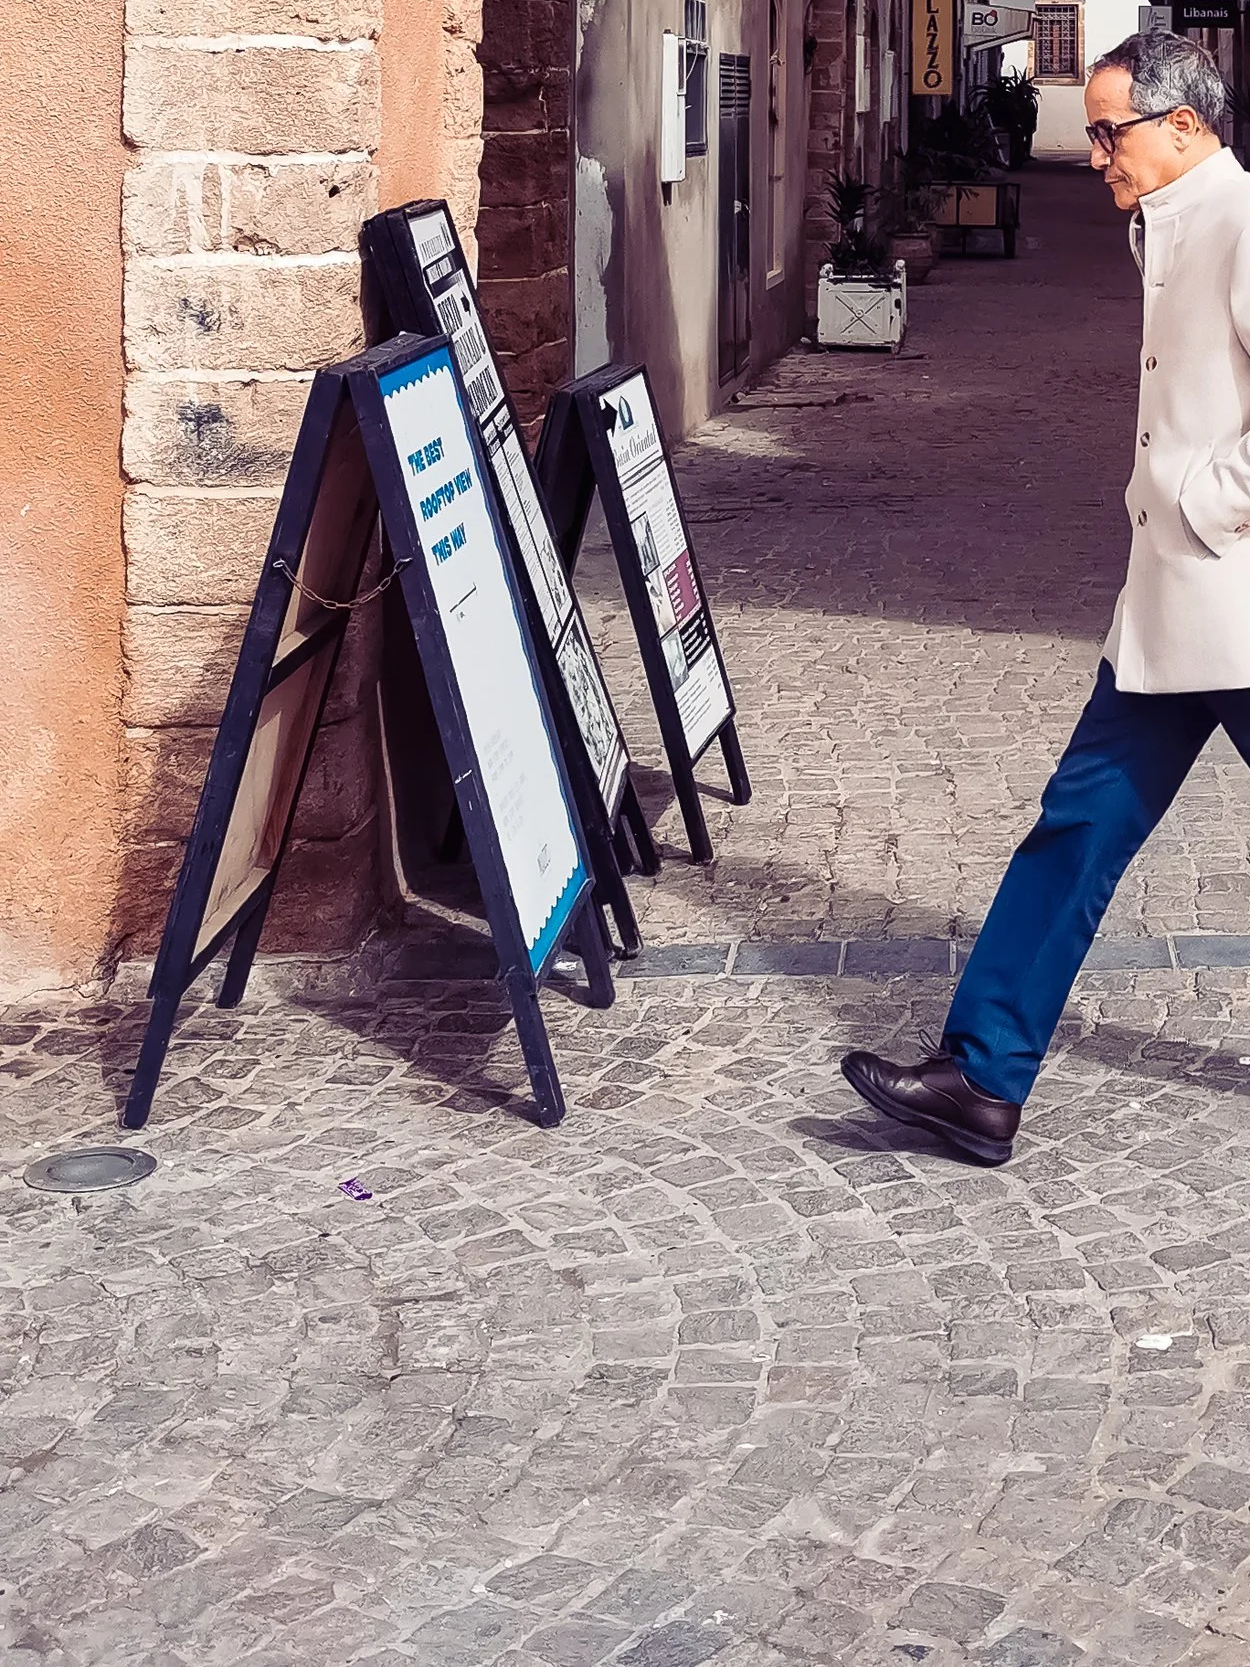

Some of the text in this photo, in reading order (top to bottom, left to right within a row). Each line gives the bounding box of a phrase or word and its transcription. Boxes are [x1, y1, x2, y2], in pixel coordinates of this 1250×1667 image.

[1183, 7, 1229, 18] Libanais
[407, 436, 446, 477] THE BEST
[629, 423, 657, 458] Oriental
[419, 480, 457, 522] ROOFTOP
[453, 467, 474, 497] VIEW
[431, 522, 468, 566] THIS WAY
